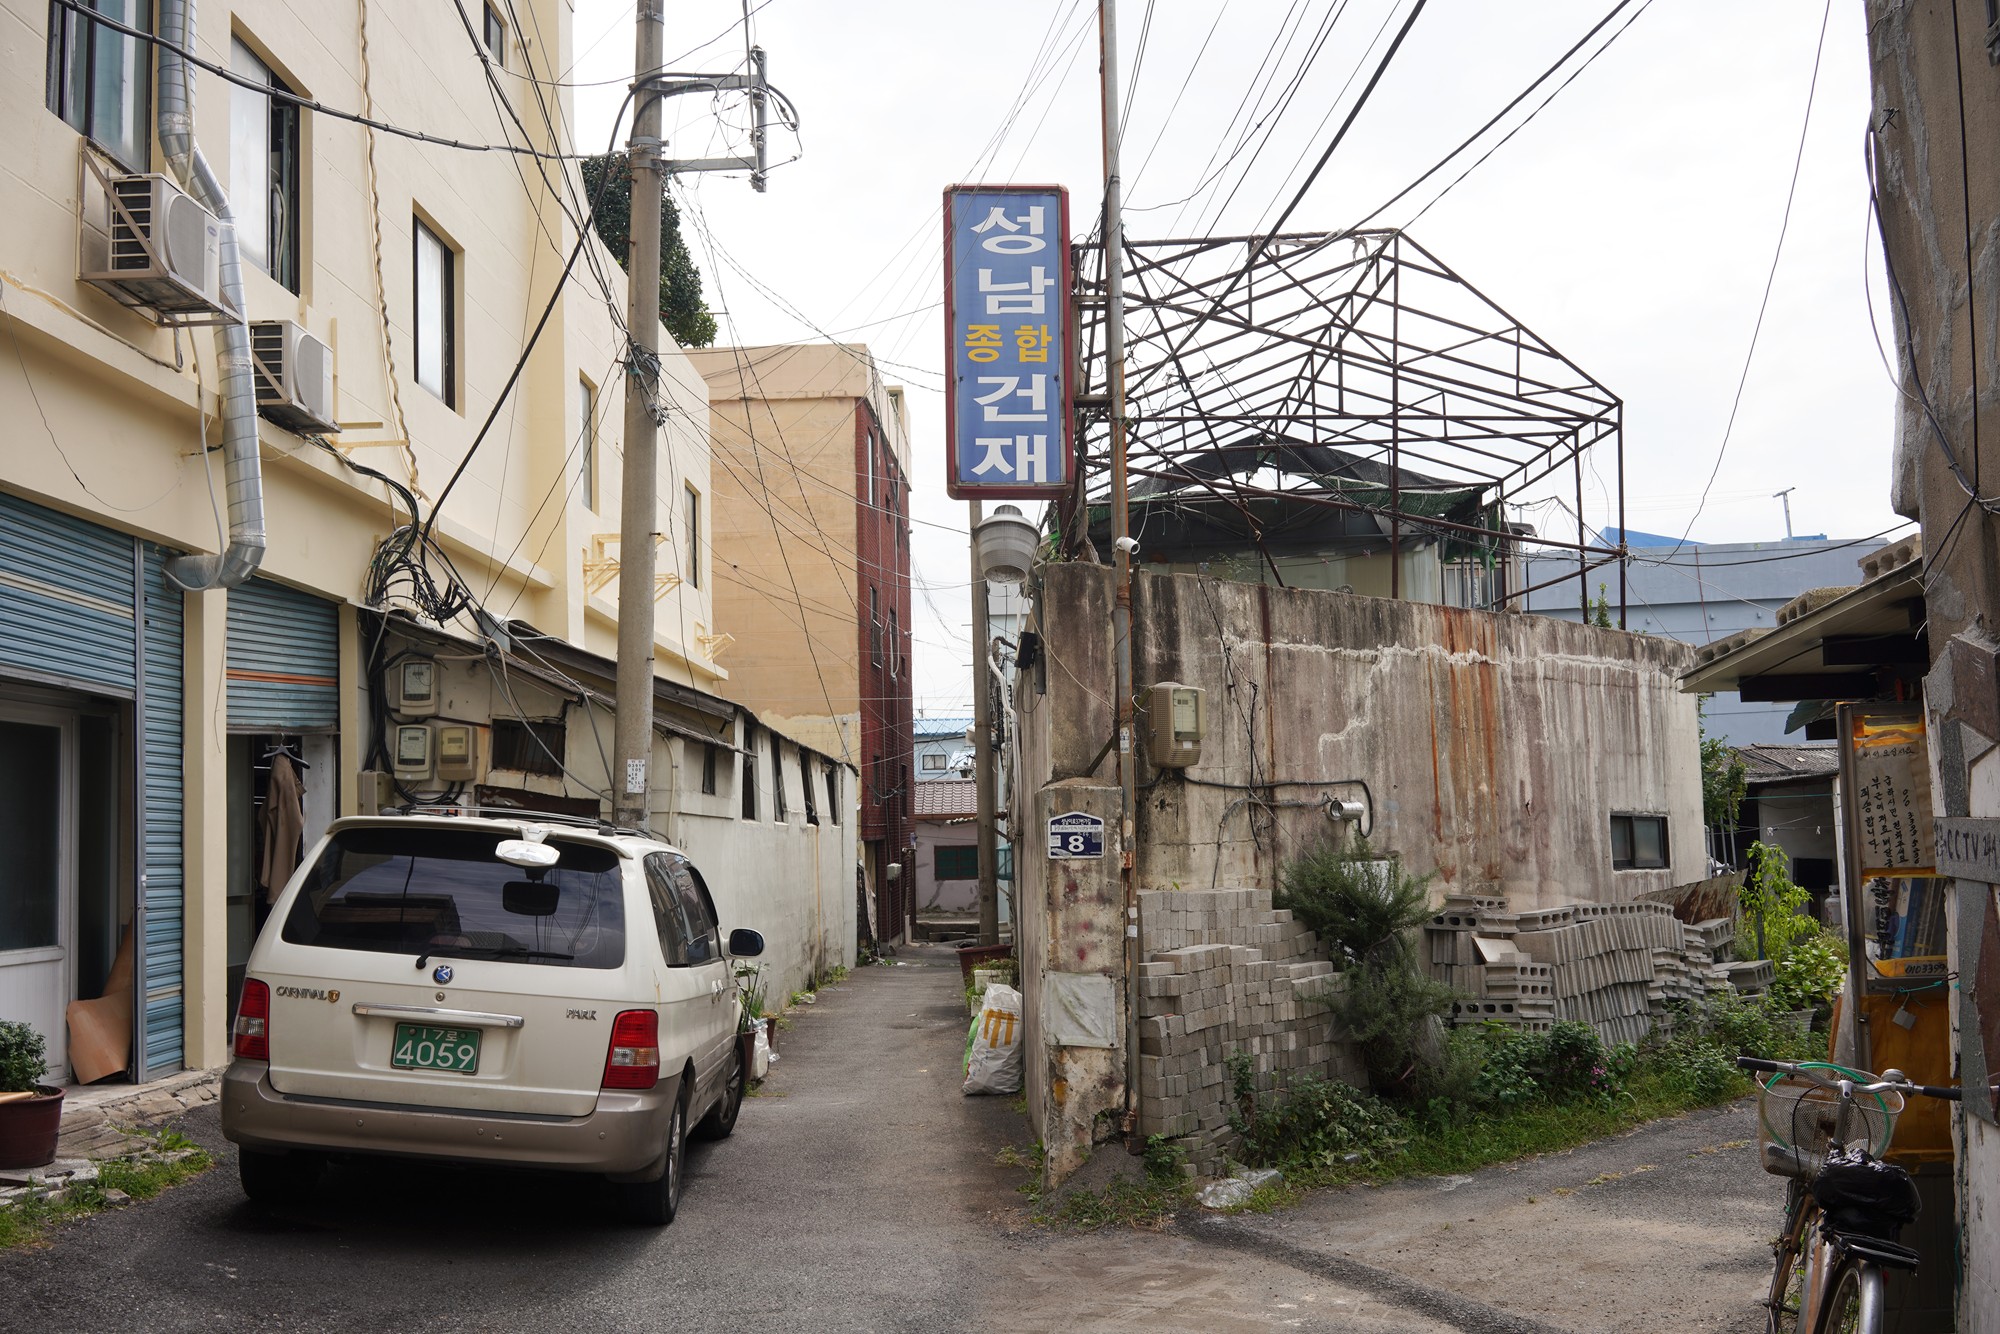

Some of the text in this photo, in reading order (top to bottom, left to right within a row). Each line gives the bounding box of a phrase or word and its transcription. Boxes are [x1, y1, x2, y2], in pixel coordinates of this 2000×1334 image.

[970, 206, 1055, 315] 성남
[964, 323, 1053, 363] 종합
[971, 373, 1048, 483] 건재
[1068, 835, 1085, 852] 8
[1947, 828, 1979, 861] CCTV
[276, 986, 327, 1001] CARNIVAL
[566, 1008, 597, 1021] PARK
[422, 1028, 458, 1042] 17로
[396, 1039, 475, 1069] 4059
